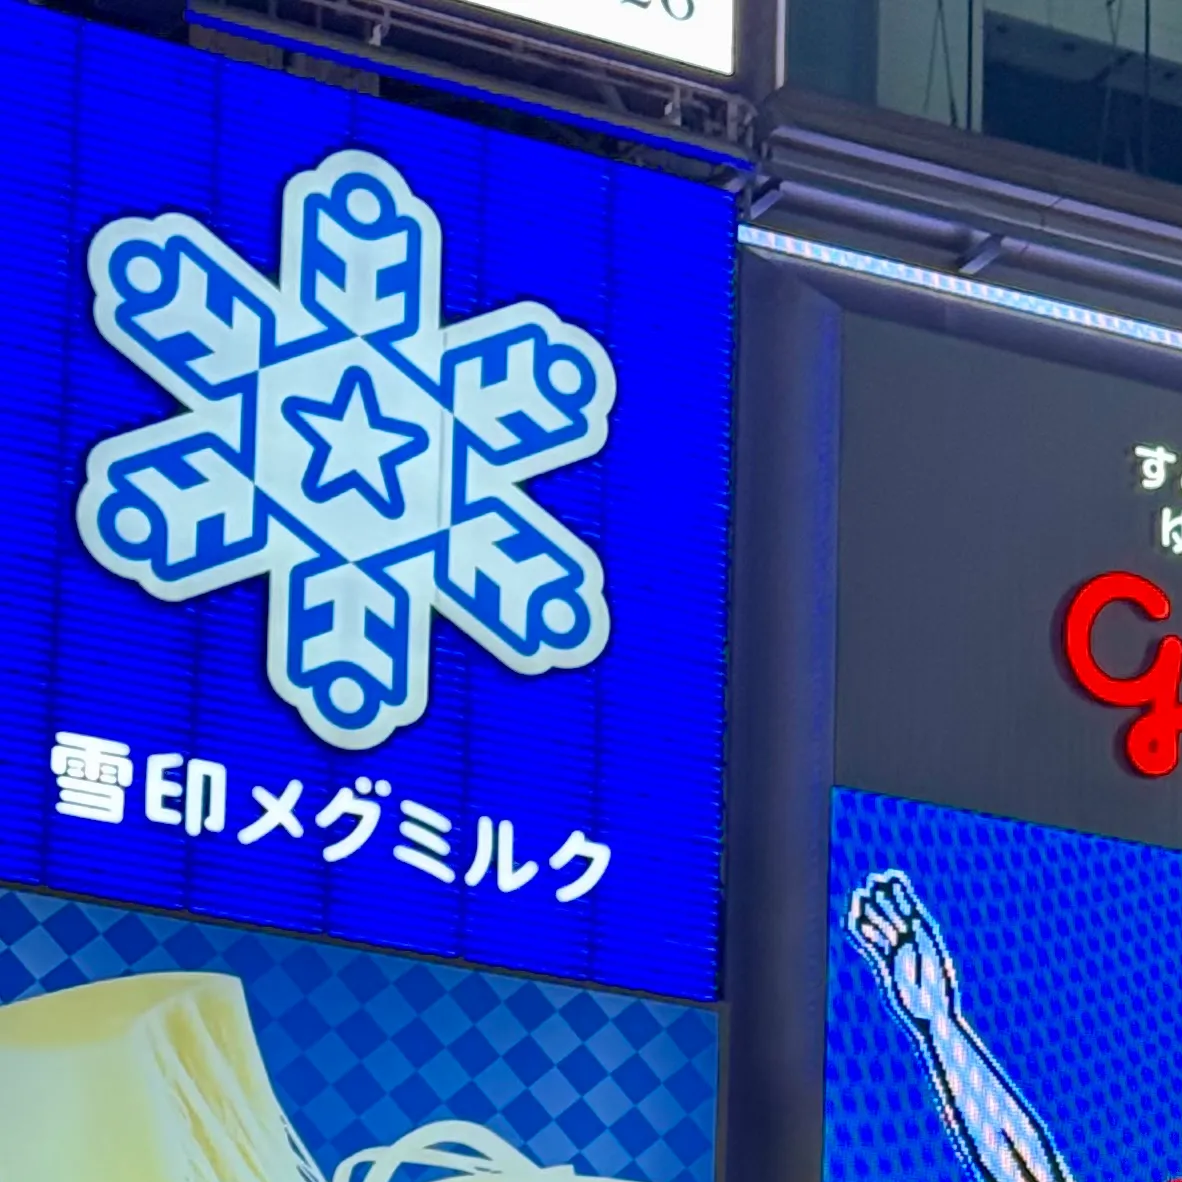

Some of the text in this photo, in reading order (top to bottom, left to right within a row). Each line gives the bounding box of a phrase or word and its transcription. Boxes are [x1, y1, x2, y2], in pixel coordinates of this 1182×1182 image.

[50, 730, 612, 903] 雪印メグミルク
